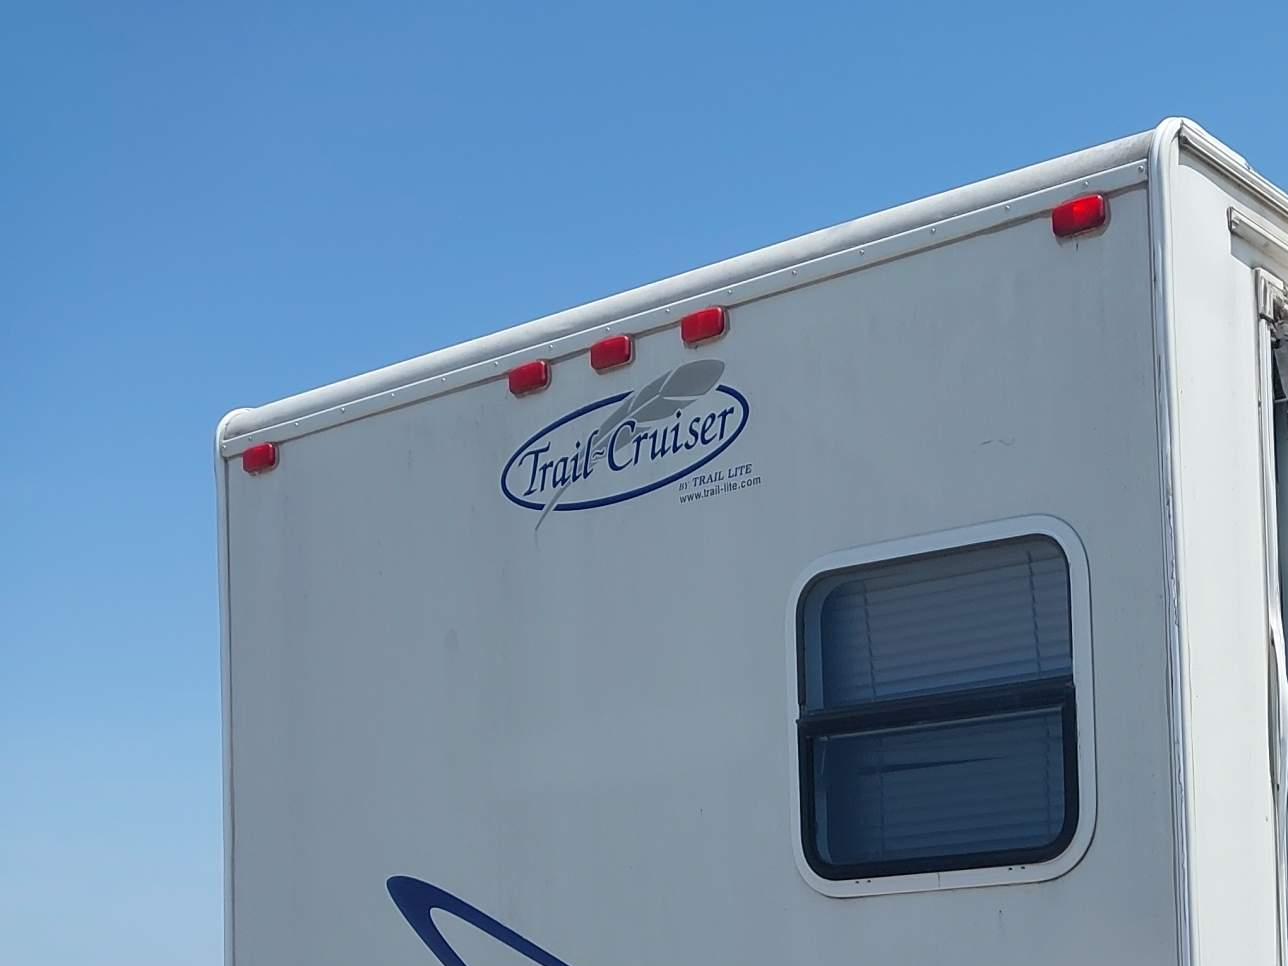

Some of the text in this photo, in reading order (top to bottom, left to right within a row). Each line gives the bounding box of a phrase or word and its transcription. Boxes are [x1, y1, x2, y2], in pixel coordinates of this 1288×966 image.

[692, 471, 725, 487] TRAIL
[727, 463, 753, 479] LITE
[679, 476, 761, 504] www.trail-lite.com
